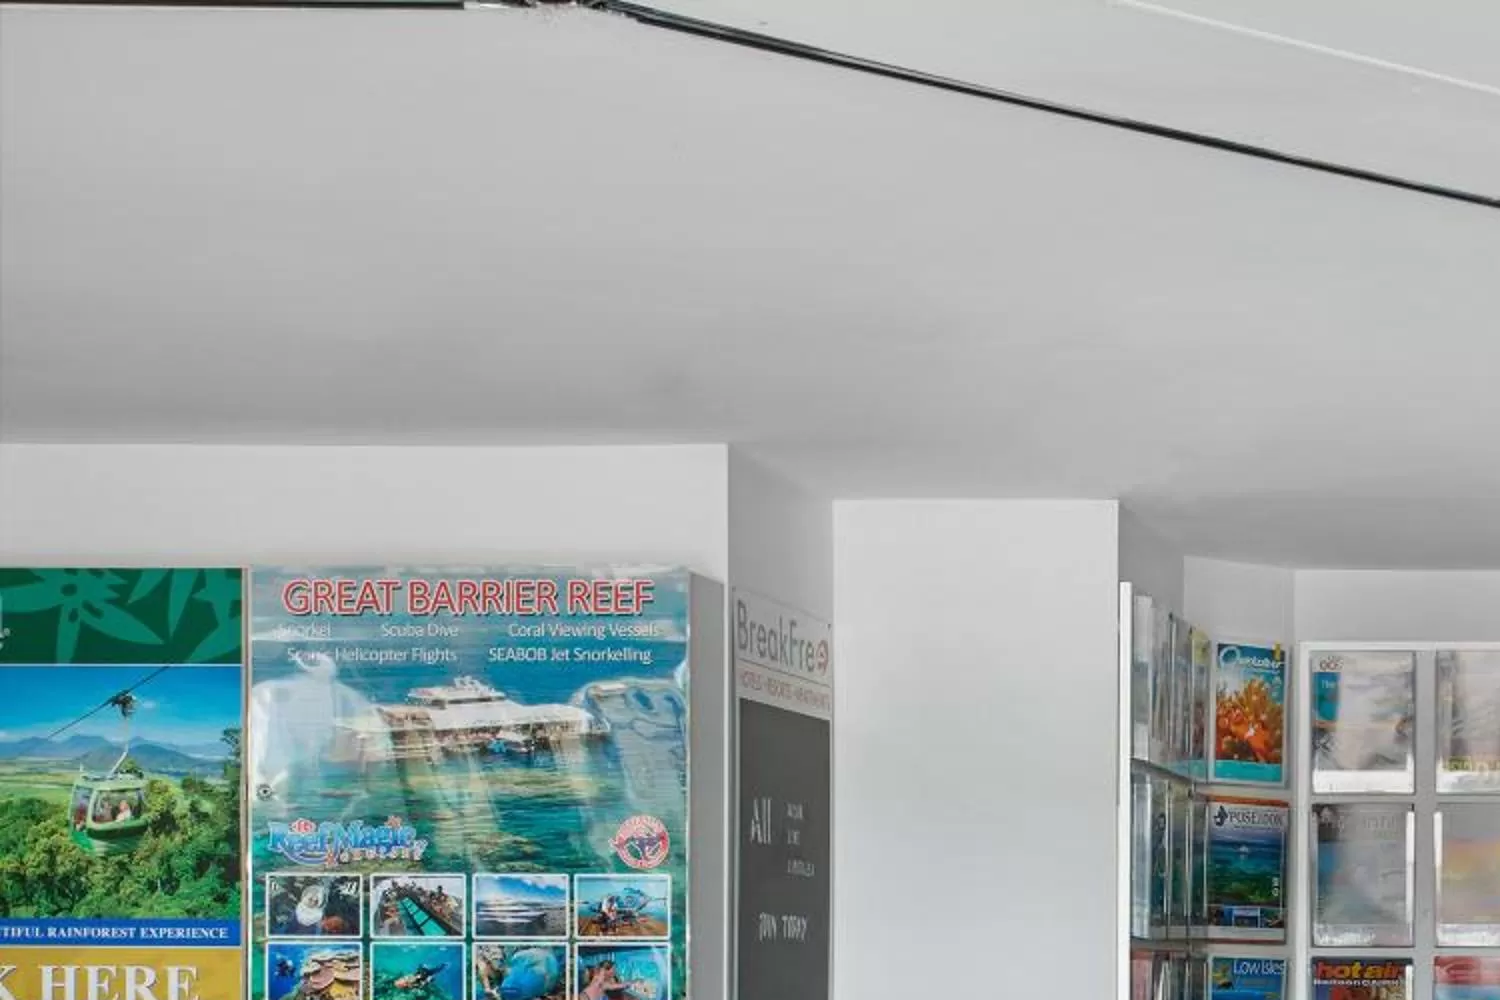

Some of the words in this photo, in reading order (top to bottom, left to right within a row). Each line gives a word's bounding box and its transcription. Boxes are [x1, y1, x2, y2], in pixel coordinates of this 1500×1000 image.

[282, 577, 402, 616] GREAT
[407, 577, 558, 616] BARRIER
[567, 577, 656, 615] REEF
[381, 622, 424, 638] Scuba
[427, 622, 459, 638] Dive
[508, 622, 545, 638] Coral
[547, 622, 606, 641] Viewing
[608, 622, 660, 638] Vessels
[336, 647, 408, 665] Helicopter
[411, 647, 458, 665] Flights
[488, 647, 547, 663] SEABOB
[551, 647, 570, 663] Jet
[574, 647, 652, 666] Snorkelling
[750, 797, 771, 845] All
[47, 926, 136, 939] RAINFOREST
[140, 926, 229, 939] EXPERIENCE
[1315, 960, 1361, 978] hot
